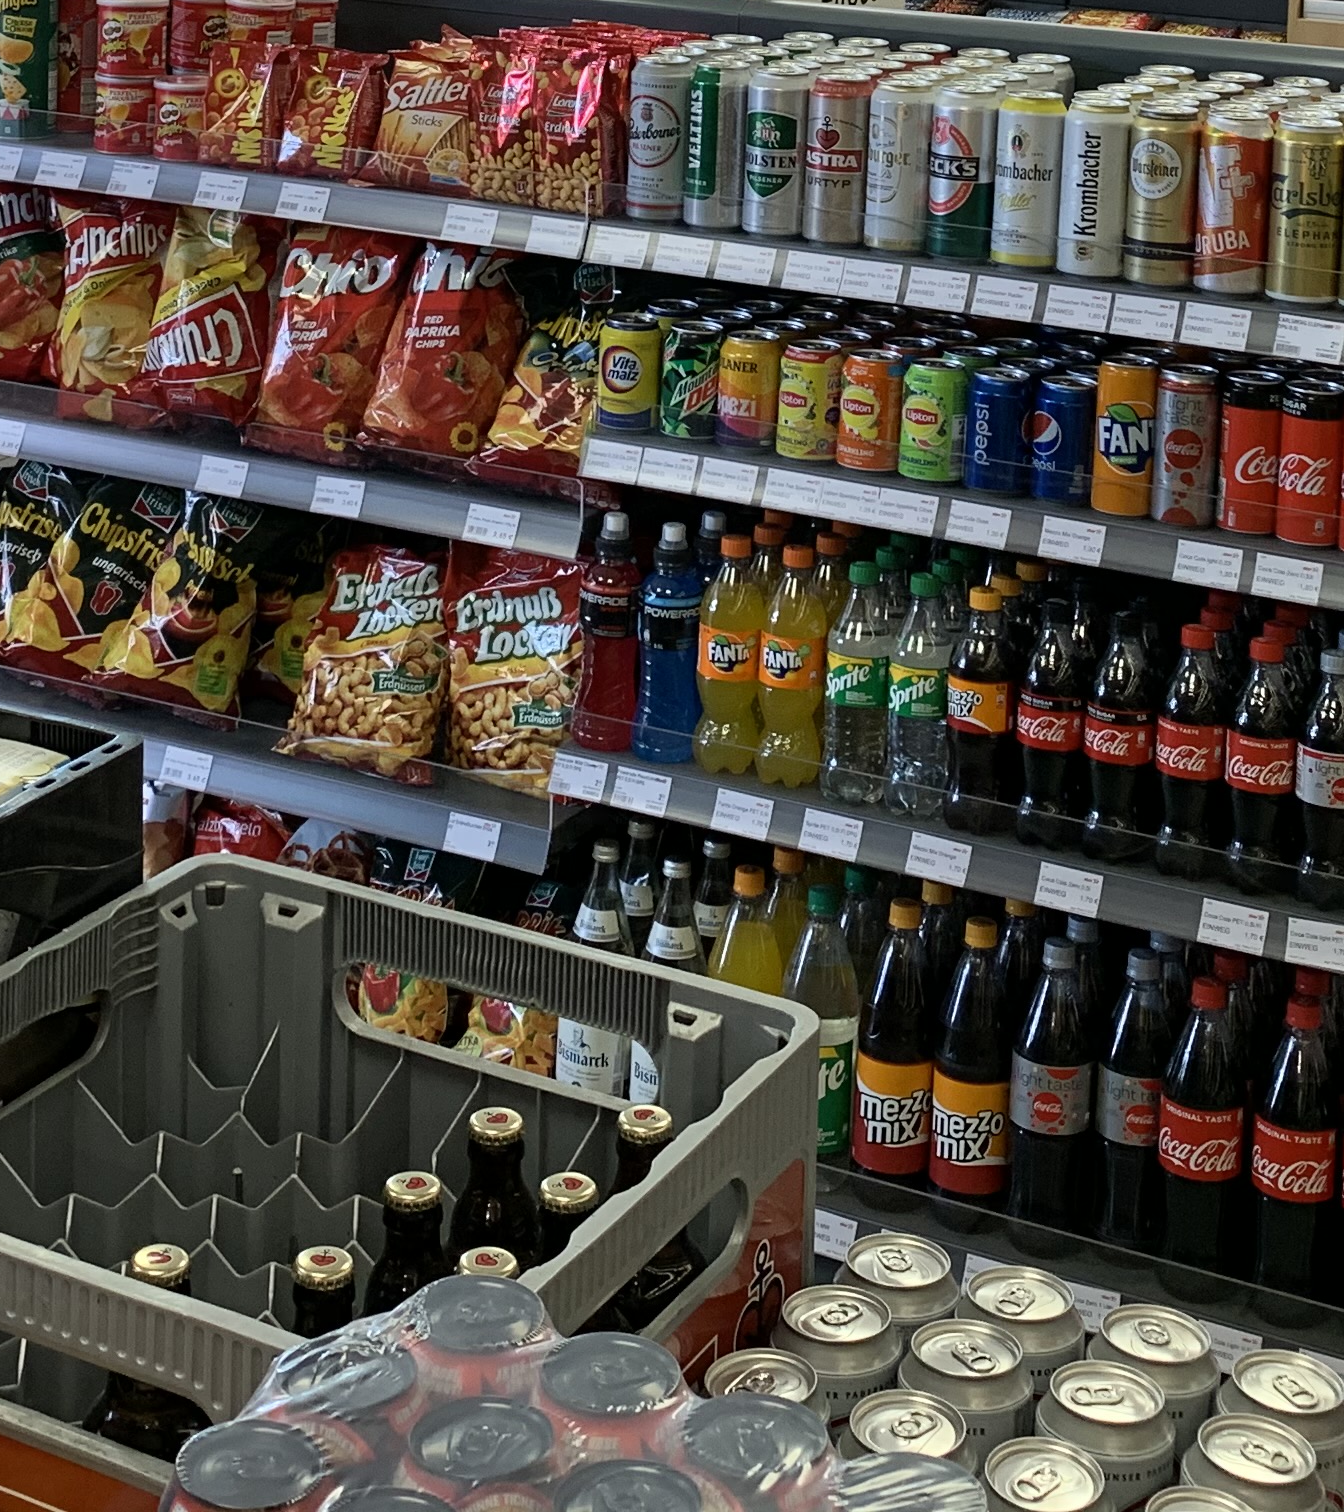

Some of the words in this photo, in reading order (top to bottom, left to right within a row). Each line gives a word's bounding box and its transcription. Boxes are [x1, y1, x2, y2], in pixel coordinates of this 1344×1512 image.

[411, 114, 444, 128] Sticks
[688, 89, 703, 169] VELTINS
[806, 152, 858, 168] ASTRA
[930, 156, 977, 178] ECK'S
[1132, 161, 1180, 179] Warsteiner
[808, 175, 851, 189] URTYP
[1073, 131, 1102, 237] Krombacher
[294, 321, 316, 329] RED
[423, 315, 444, 325] RED
[405, 324, 460, 338] PAPRIKA
[415, 339, 446, 349] CHIPS
[611, 354, 638, 370] Vita
[607, 367, 640, 382] malz
[780, 391, 805, 406] Lipton
[844, 400, 872, 414] Lipton
[1168, 396, 1203, 415] light
[1283, 399, 1307, 410] SUGAR
[906, 410, 936, 423] Lipton
[1166, 410, 1207, 427] taste
[974, 403, 990, 466] pepsi
[838, 445, 874, 458] SPARKLING
[1165, 441, 1201, 456] Coca-Cola
[900, 457, 938, 466] SPARKLING
[92, 554, 148, 592] ungarisch
[347, 595, 446, 641] Locken
[455, 588, 563, 633] Erdnuß
[708, 641, 750, 662] FANTA
[763, 646, 803, 670] FANTA
[378, 677, 426, 693] Erdnüssen
[826, 665, 870, 696] Sprite
[888, 676, 935, 709] Sprite
[948, 688, 982, 707] mezzo
[948, 702, 974, 717] mix
[1098, 712, 1116, 720] SUGAR
[518, 712, 564, 727] Erdnüssen
[1180, 727, 1199, 735] TASTE
[1229, 755, 1293, 786] Coca-Cola
[1313, 760, 1342, 777] light
[1039, 885, 1067, 898] EINWEG
[1202, 923, 1230, 934] EINWEG
[1289, 941, 1318, 952] EINWEG
[558, 1036, 610, 1070] Bismarck
[1015, 1069, 1048, 1092] light
[1050, 1076, 1084, 1091] taste
[858, 1087, 932, 1124] mezzo
[1032, 1097, 1063, 1114] Coca-Cola
[1164, 1102, 1204, 1120] ORIGINAL
[1204, 1110, 1233, 1124] TASTE
[866, 1114, 919, 1147] mix
[932, 1107, 1004, 1140] mezzo
[1258, 1121, 1301, 1142] ORIGINAL
[1302, 1132, 1323, 1146] TASTE
[935, 1133, 990, 1163] mix
[1158, 1124, 1238, 1174] Coca-Cola
